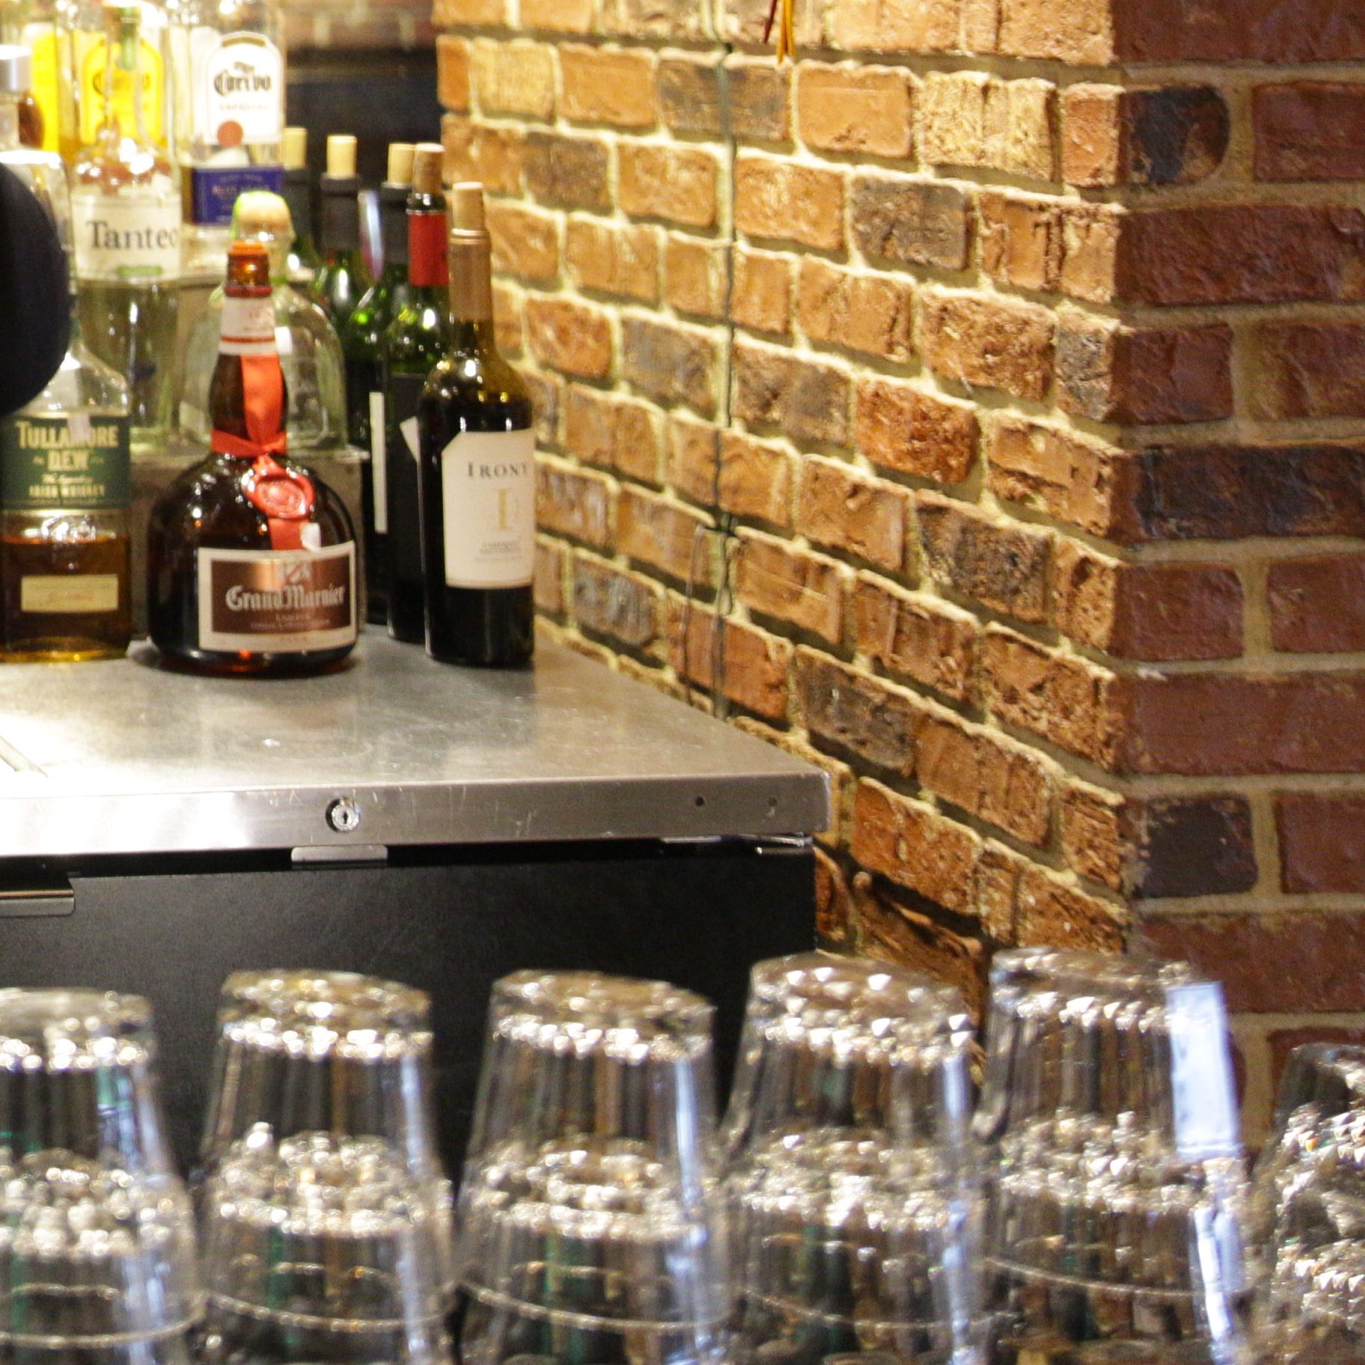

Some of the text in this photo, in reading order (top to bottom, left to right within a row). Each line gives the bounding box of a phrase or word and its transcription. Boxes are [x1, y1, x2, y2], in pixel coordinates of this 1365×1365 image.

[214, 70, 272, 96] Cuervo
[48, 450, 89, 471] DEW
[467, 462, 529, 479] IRONY
[225, 583, 346, 612] Grand Marnier
